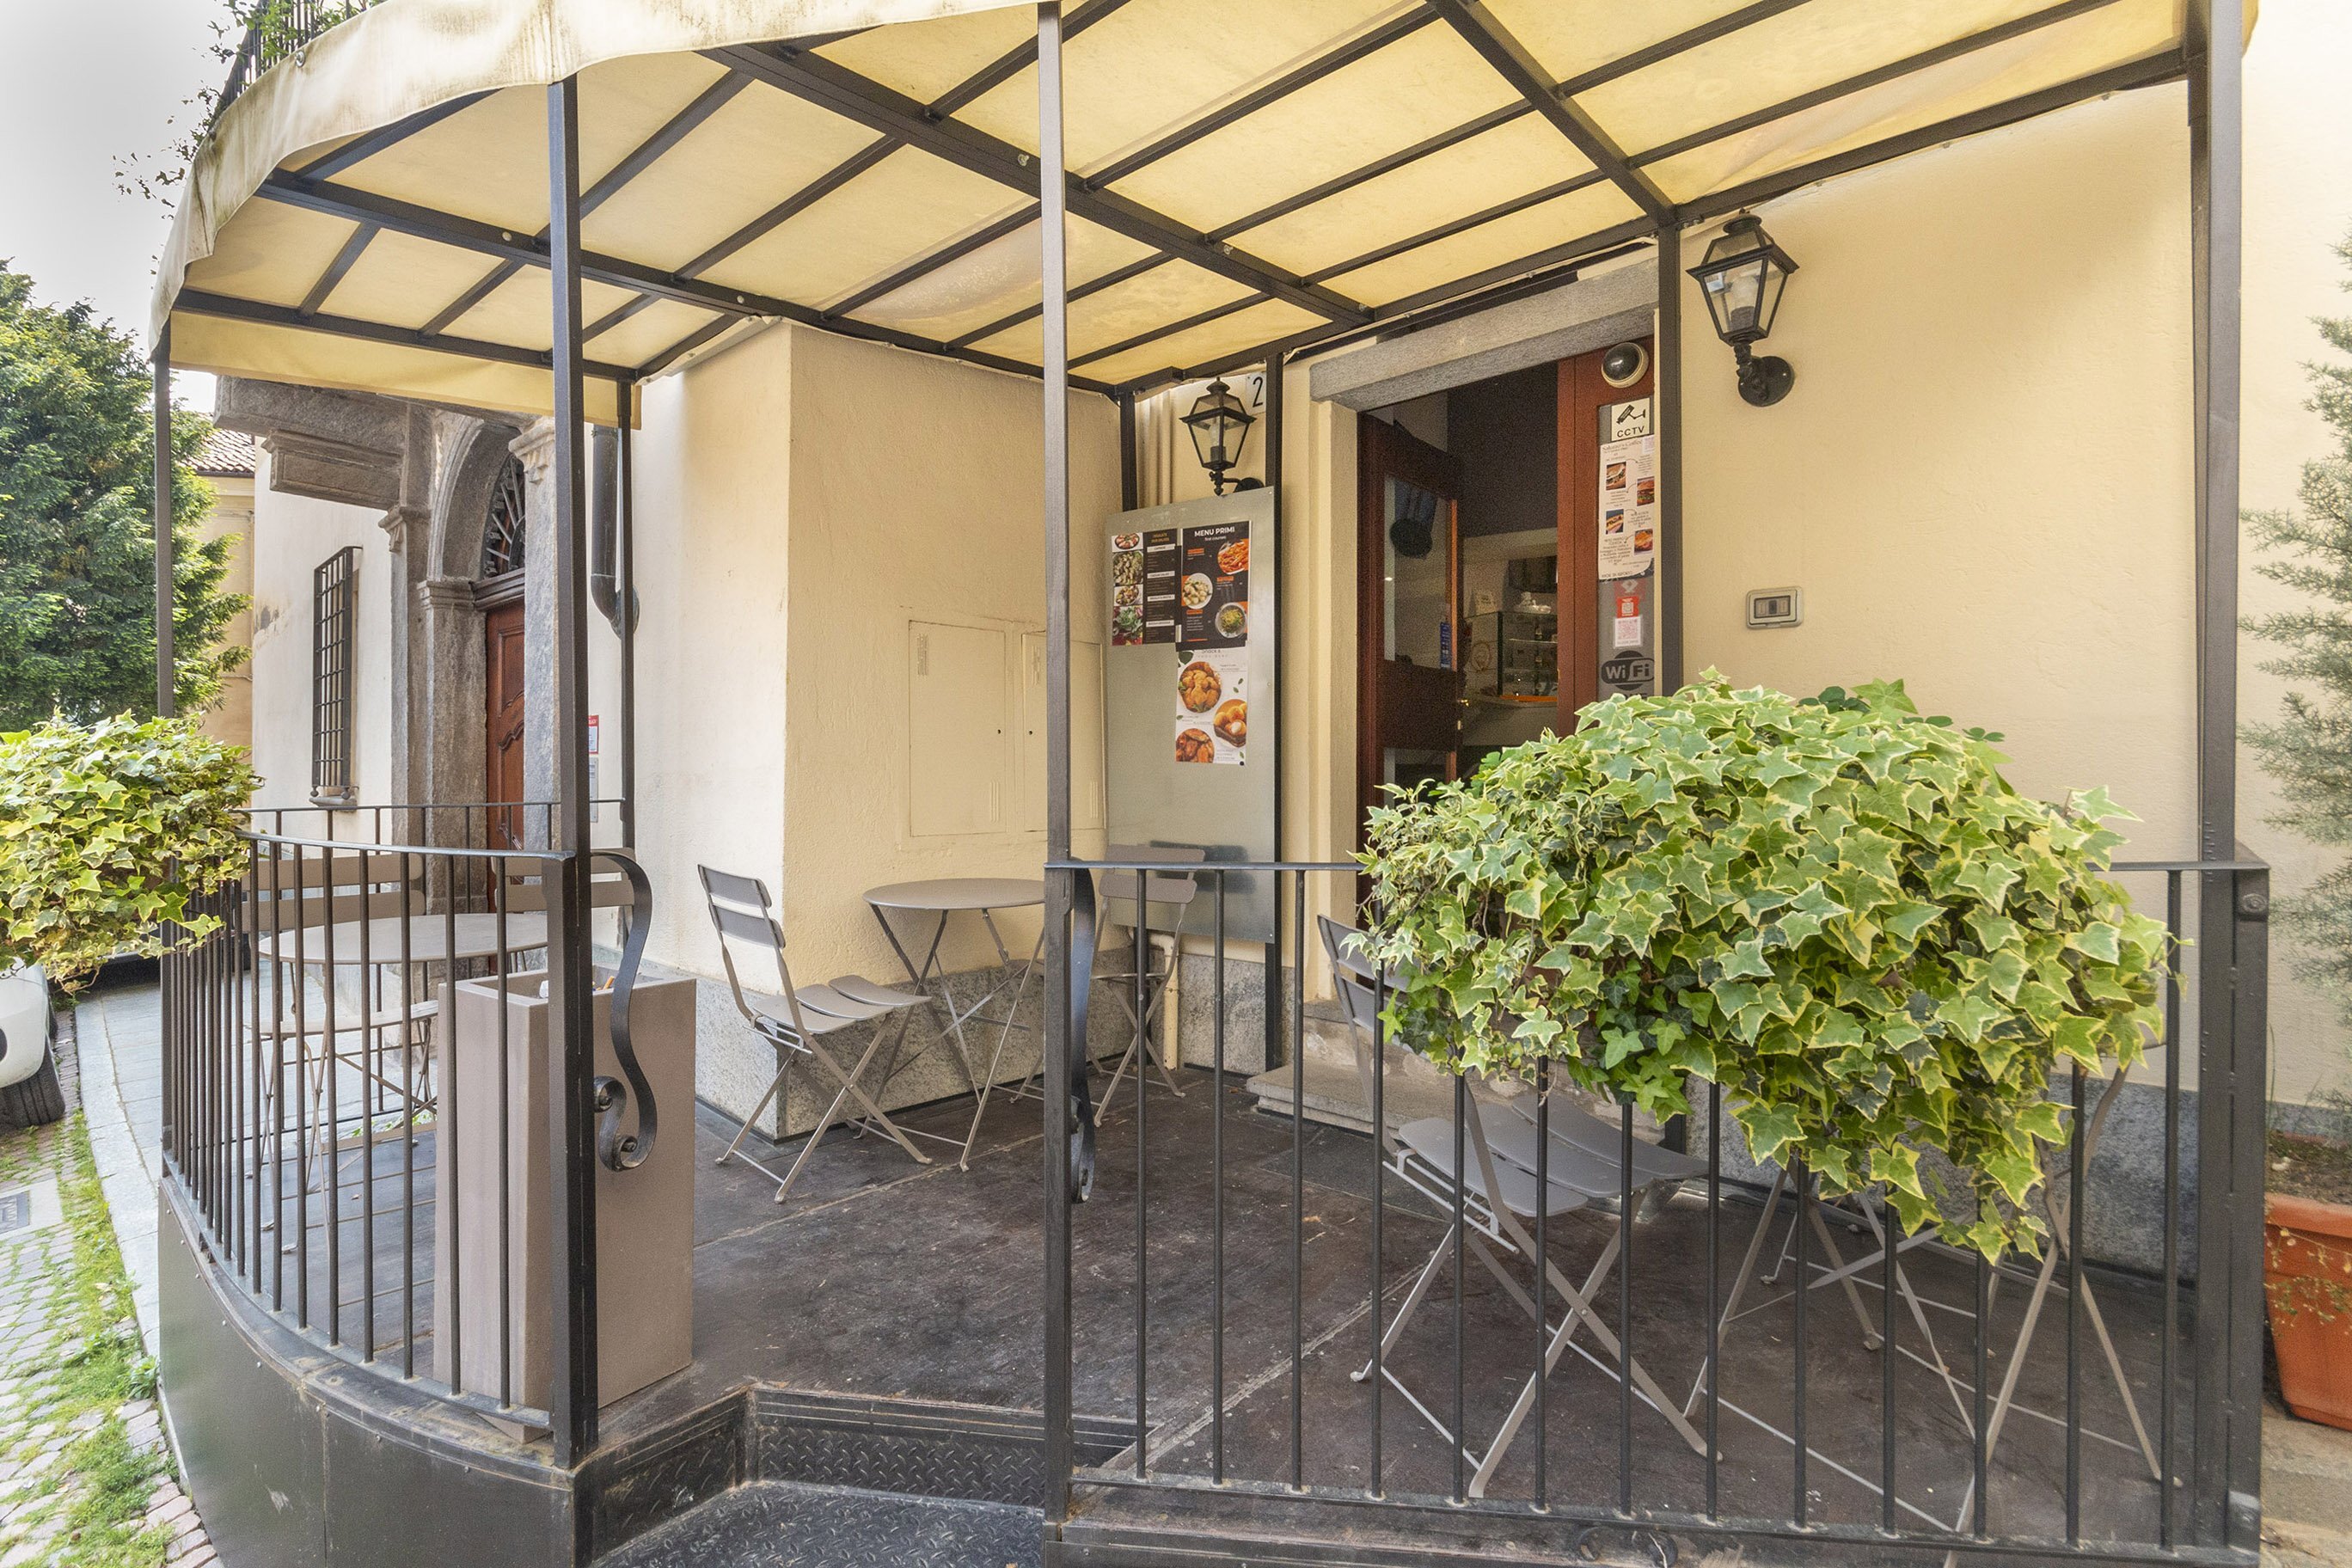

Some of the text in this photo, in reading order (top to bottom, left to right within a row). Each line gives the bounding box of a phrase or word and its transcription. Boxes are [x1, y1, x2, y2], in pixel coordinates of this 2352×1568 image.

[1253, 377, 1264, 407] 2
[1617, 426, 1645, 438] CCTV
[1194, 526, 1235, 537] MENU PRIMI
